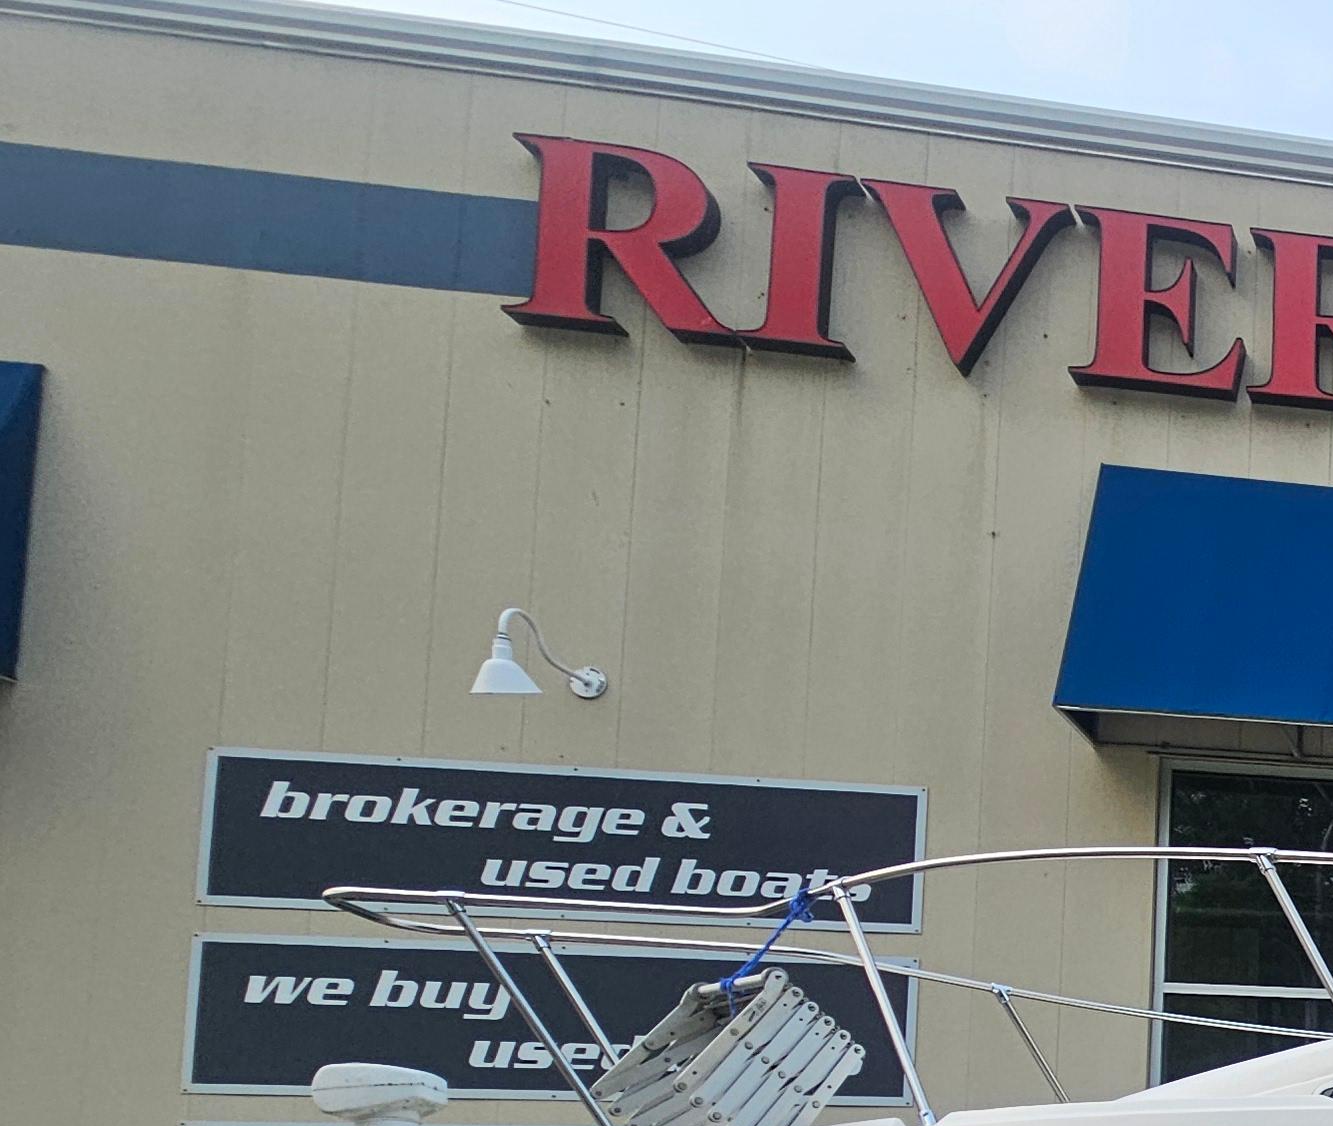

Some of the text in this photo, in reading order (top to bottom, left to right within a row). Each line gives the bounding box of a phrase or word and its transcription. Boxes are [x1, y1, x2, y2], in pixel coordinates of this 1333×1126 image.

[260, 780, 711, 843] brokerage &
[480, 857, 661, 893] used
[244, 970, 512, 1021] we buy
